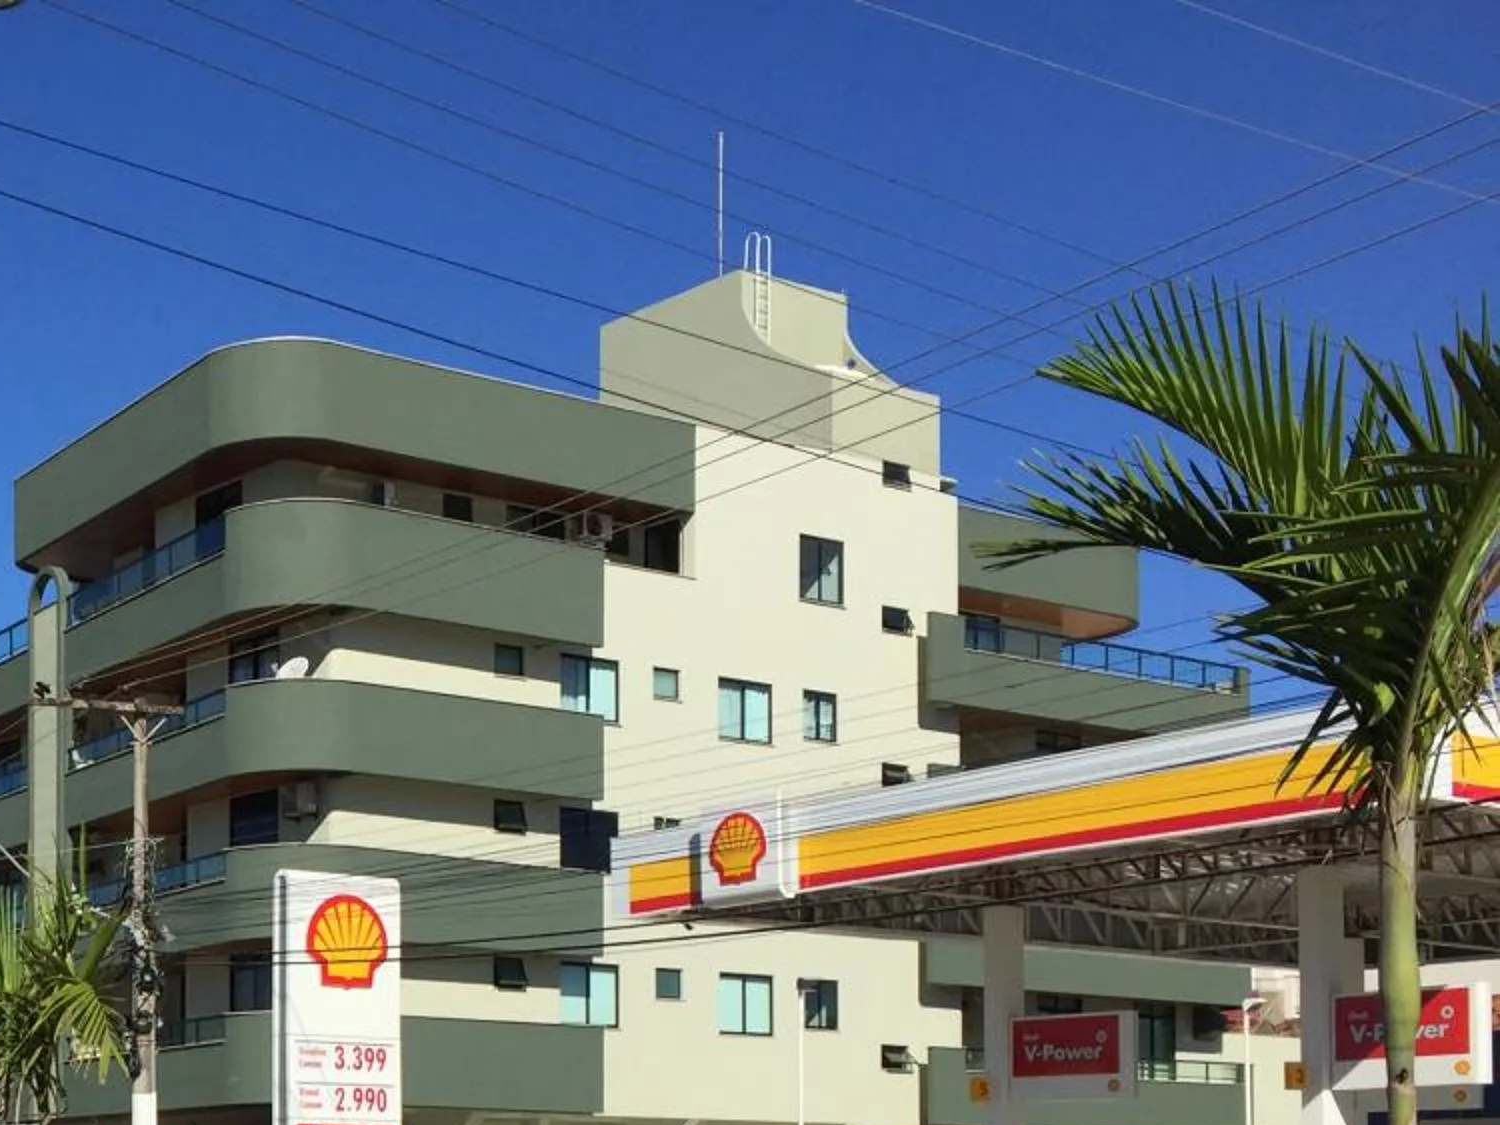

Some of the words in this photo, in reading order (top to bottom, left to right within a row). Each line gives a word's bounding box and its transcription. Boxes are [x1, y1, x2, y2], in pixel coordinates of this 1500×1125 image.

[1350, 1023, 1450, 1043] V-Per
[334, 1045, 387, 1072] 3.399
[1025, 1044, 1104, 1063] V-Power
[334, 1087, 387, 1113] 2.990
